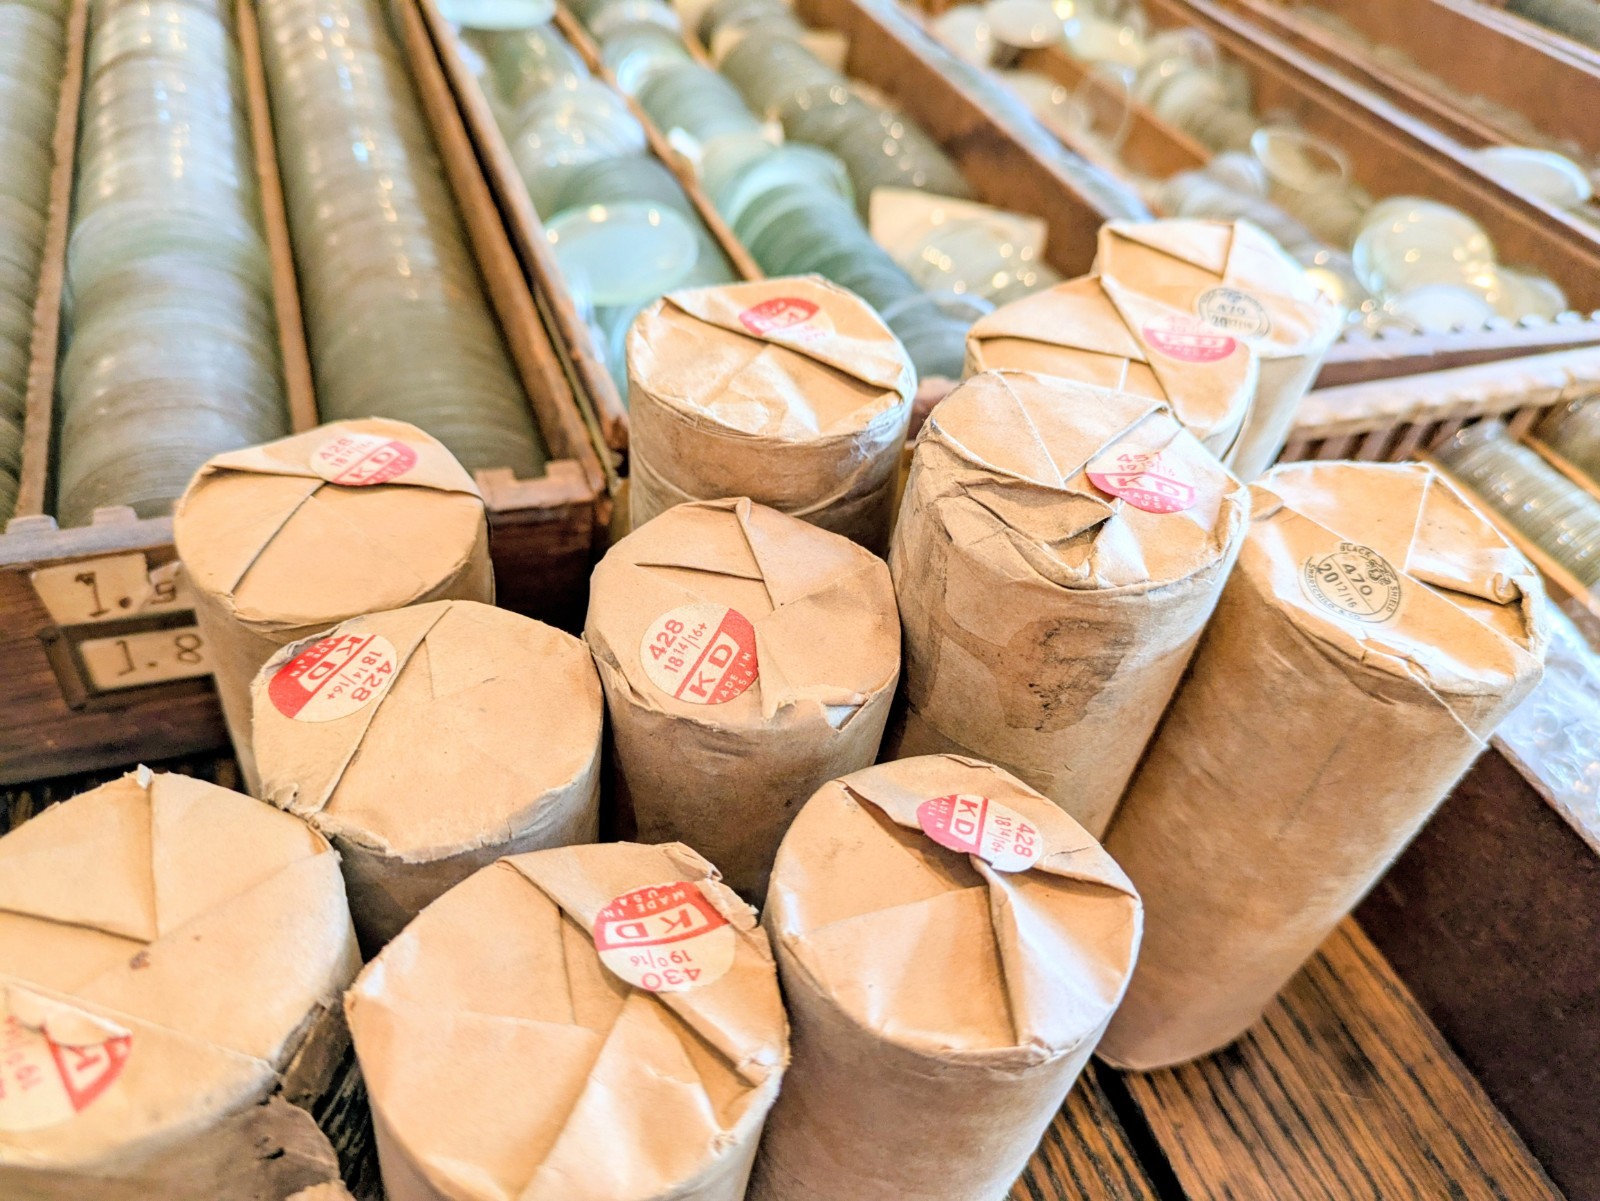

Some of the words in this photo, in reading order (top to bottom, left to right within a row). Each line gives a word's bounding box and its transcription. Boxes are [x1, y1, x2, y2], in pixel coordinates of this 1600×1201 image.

[1116, 475, 1181, 497] KD
[1340, 543, 1372, 558] BLACK
[1385, 586, 1398, 612] SHIELD
[1341, 563, 1373, 596] 470
[114, 633, 202, 677] 1.8
[649, 619, 685, 660] 428
[307, 636, 365, 681] KD
[689, 644, 733, 698] KD
[738, 652, 752, 668] IN
[351, 660, 393, 702] 428
[732, 670, 753, 696] USA
[954, 798, 979, 836] KD
[1013, 822, 1036, 859] 428
[602, 908, 625, 918] IN
[618, 889, 659, 907] USA
[636, 889, 686, 913] MADE
[615, 908, 693, 939] KD
[641, 967, 702, 991] 430
